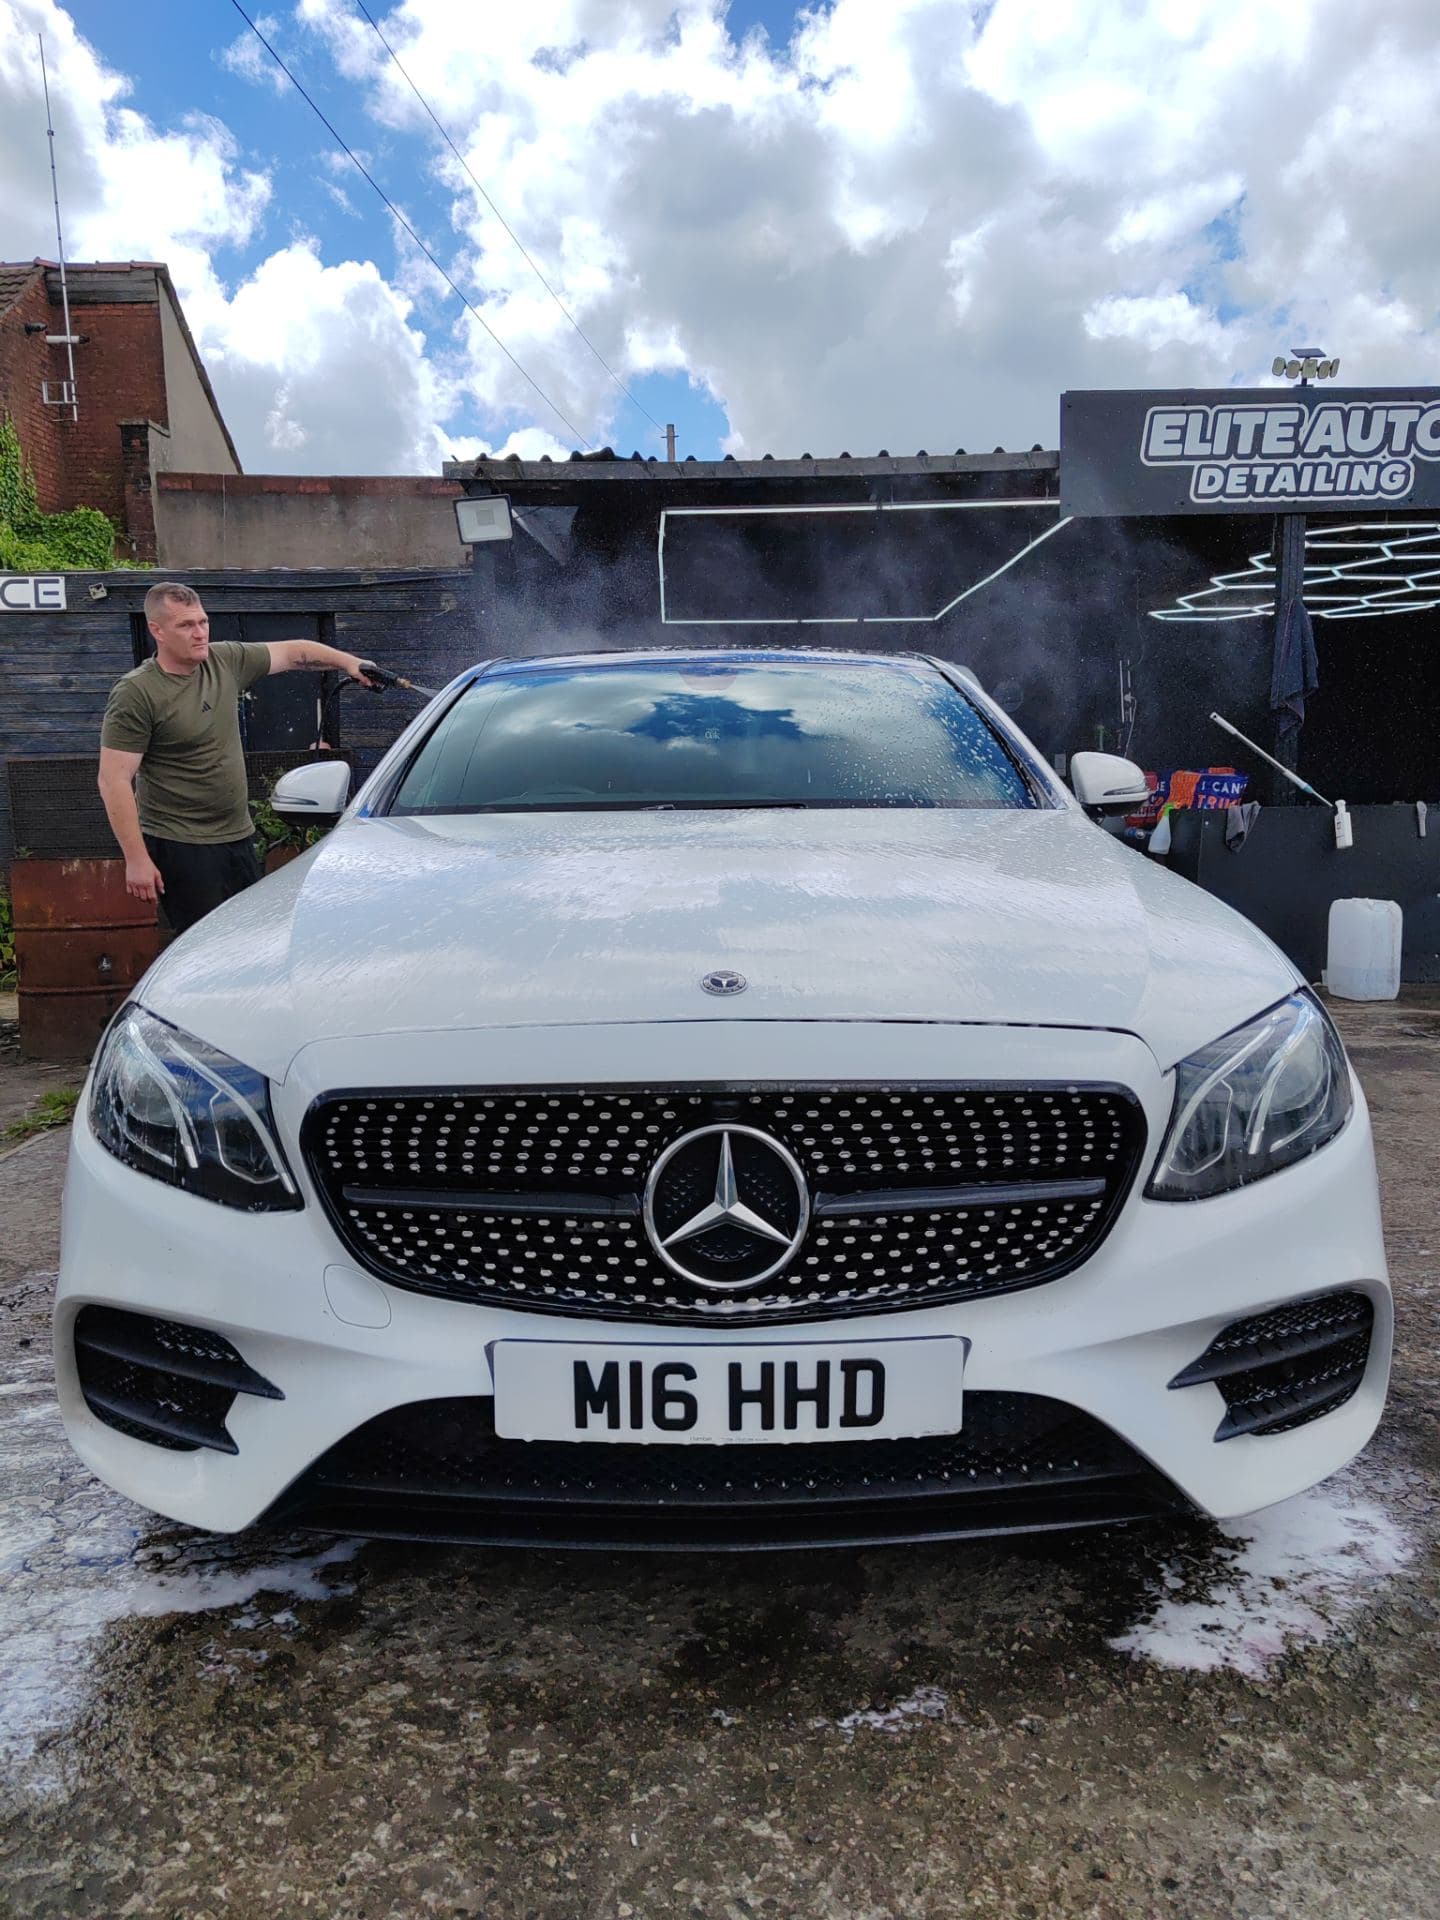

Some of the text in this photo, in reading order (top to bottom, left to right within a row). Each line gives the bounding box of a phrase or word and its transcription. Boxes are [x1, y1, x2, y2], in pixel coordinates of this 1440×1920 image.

[1148, 408, 1440, 457] ELITE AUTO
[1197, 463, 1408, 494] DETAILING
[0, 579, 61, 608] CE
[728, 1358, 886, 1431] HHD
